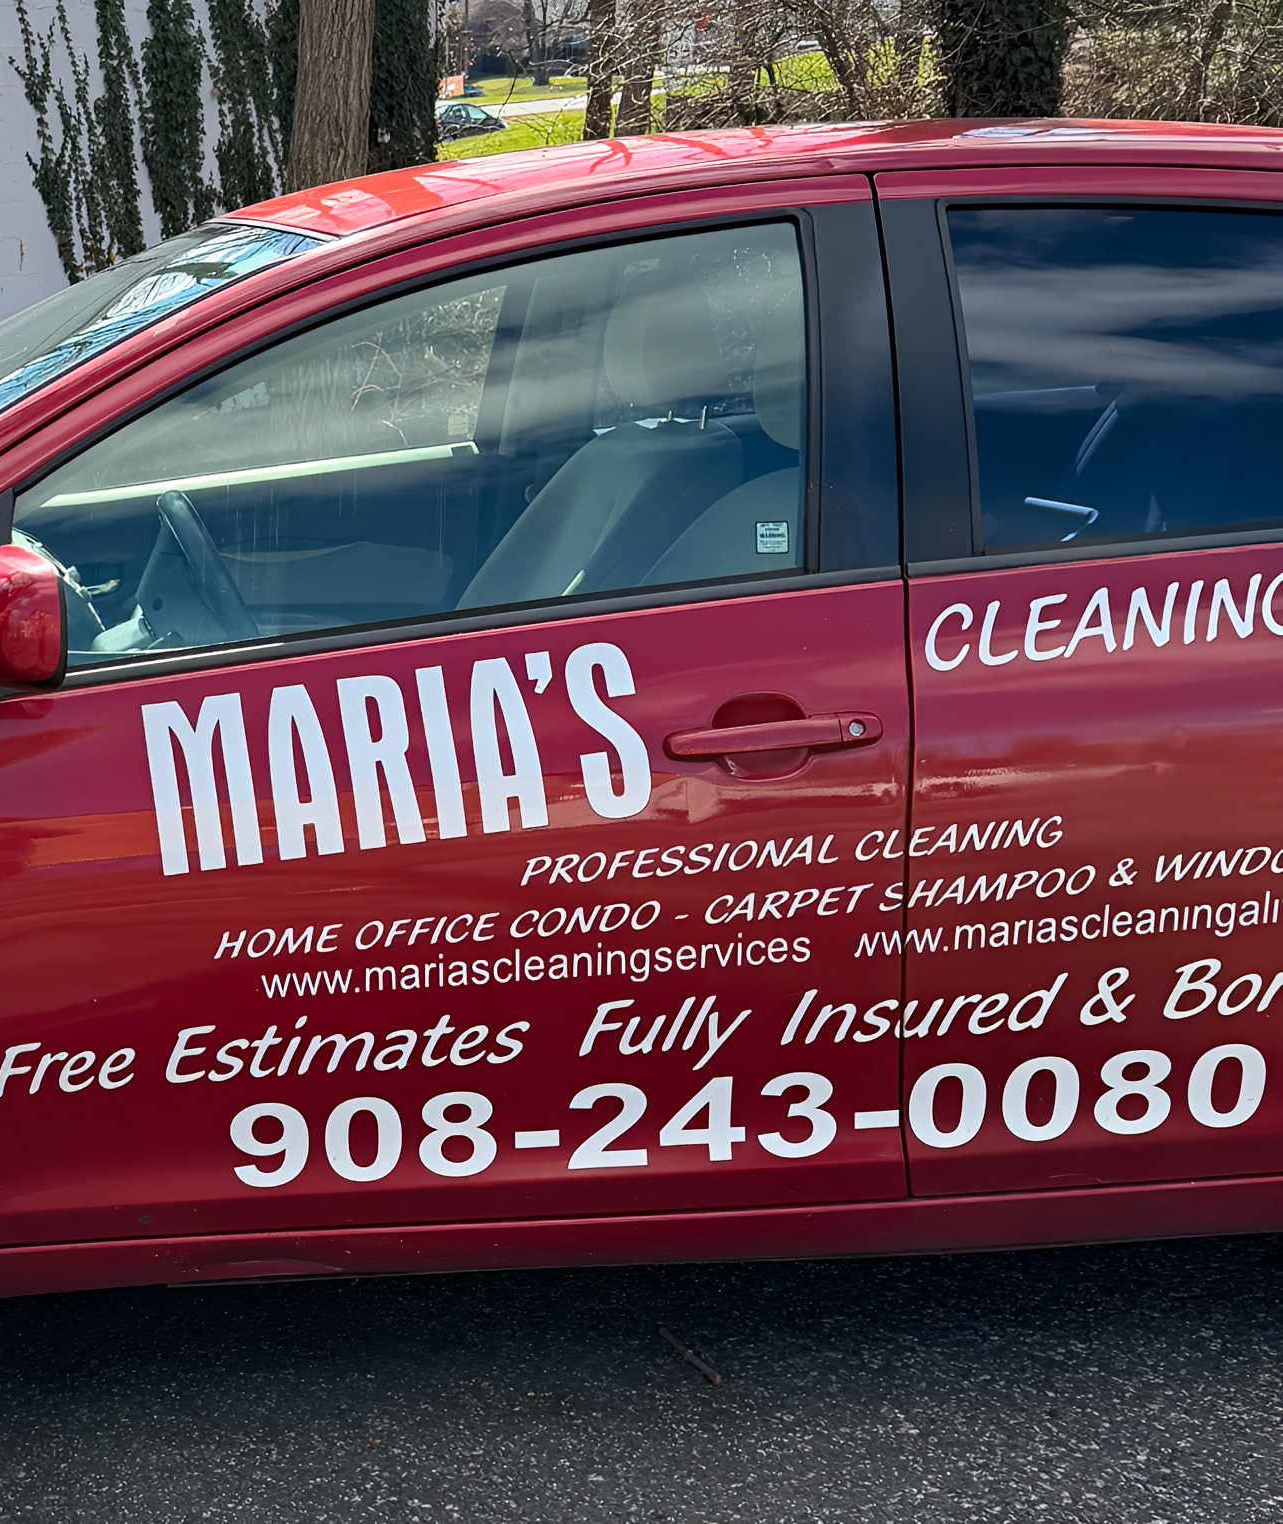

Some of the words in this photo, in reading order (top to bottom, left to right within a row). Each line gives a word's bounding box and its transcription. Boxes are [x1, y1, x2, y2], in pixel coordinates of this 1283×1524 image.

[140, 642, 652, 877] MARIA'S
[521, 834, 839, 886] PROFESSIONAL
[854, 816, 1063, 867] CLEANING
[214, 924, 343, 960] HOME
[355, 913, 500, 950] OFFICE
[509, 900, 661, 939] CONDO
[704, 883, 874, 925] CARPET
[879, 864, 1096, 912] SHAMPOO
[1108, 857, 1138, 887] &
[261, 931, 811, 999] www.mariascleaningservices
[165, 1015, 531, 1084] Estimates
[578, 995, 753, 1071] Fully
[780, 972, 1069, 1046] Insured
[1079, 966, 1136, 1026] &
[229, 1043, 1267, 1188] 908-243-0080
